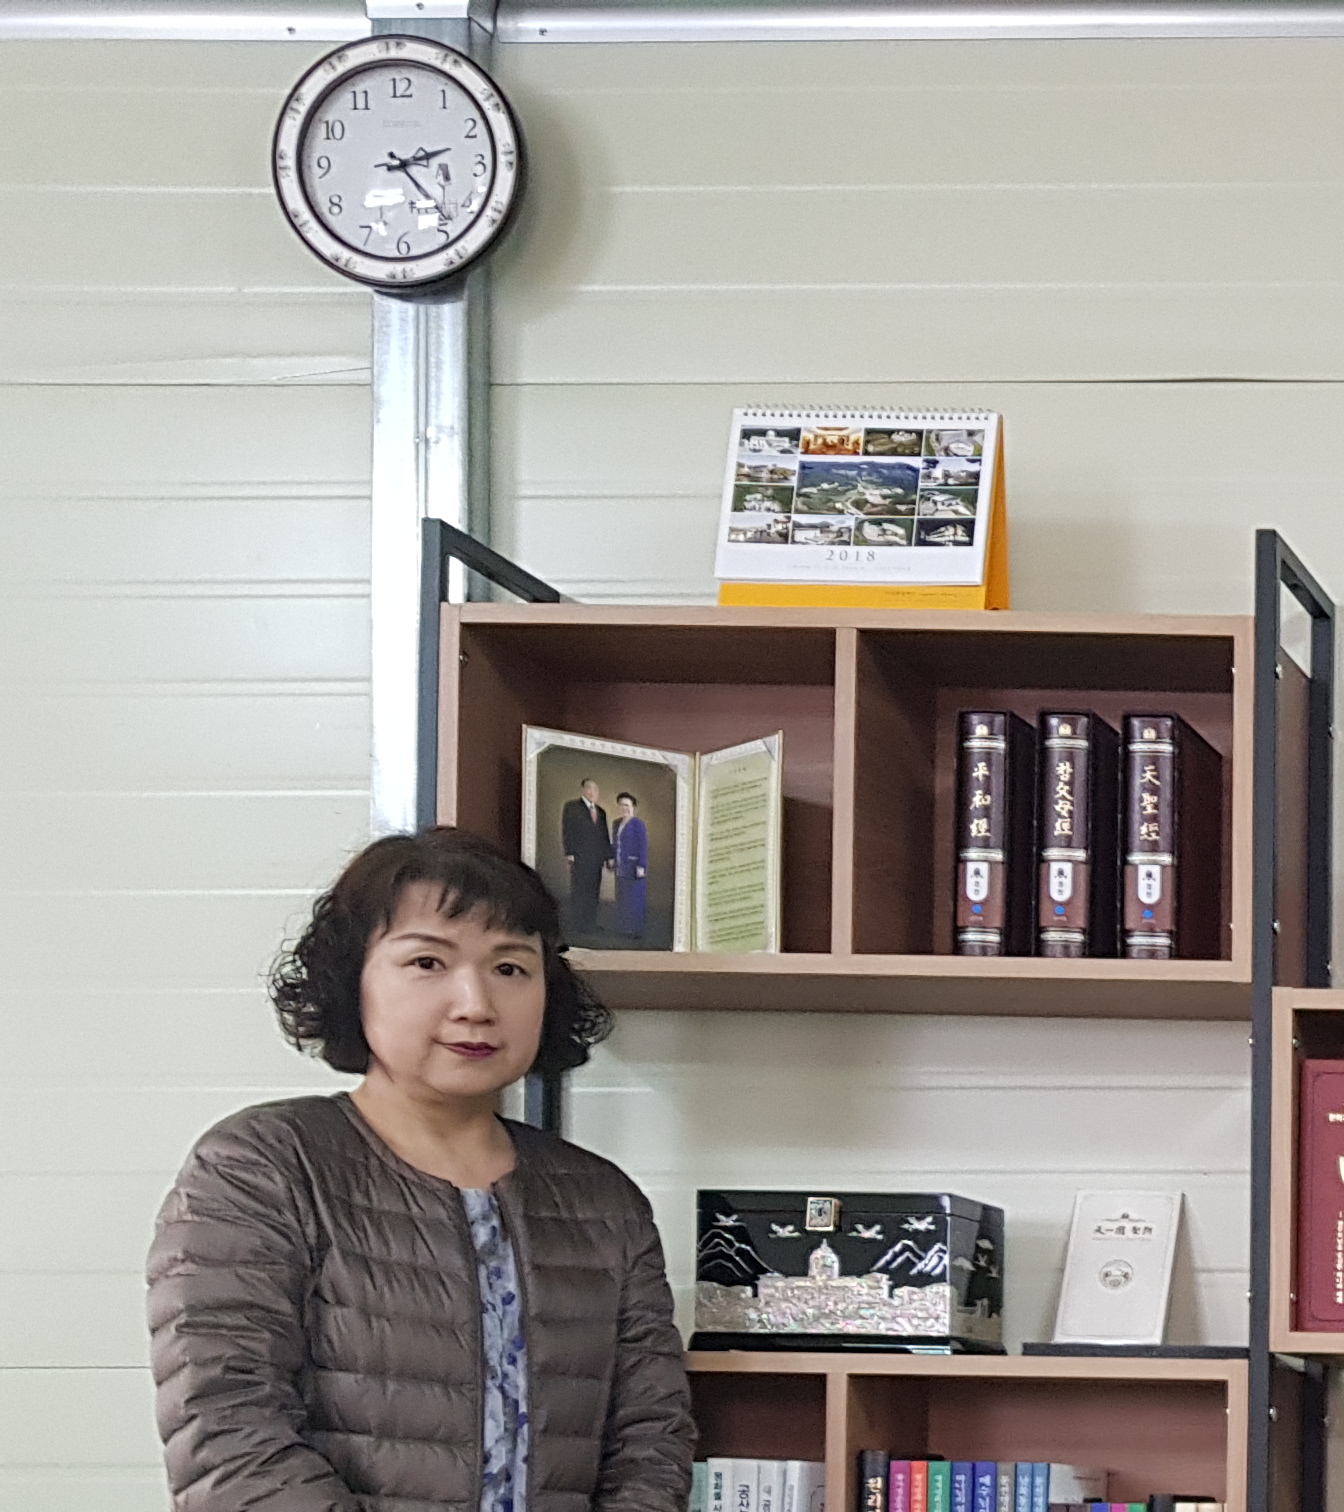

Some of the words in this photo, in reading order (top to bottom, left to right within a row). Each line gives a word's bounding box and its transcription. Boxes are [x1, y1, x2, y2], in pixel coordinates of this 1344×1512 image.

[389, 77, 413, 98] 12
[351, 90, 371, 111] 11
[441, 89, 448, 110] 1
[323, 119, 345, 141] 10
[464, 118, 477, 139] 2
[317, 155, 331, 179] 9
[473, 153, 487, 177] 3
[329, 195, 343, 215] 8
[359, 225, 373, 246] 7
[437, 220, 449, 242] 5
[396, 232, 411, 256] 6
[825, 549, 877, 562] 2018
[969, 762, 992, 838] 平和經
[1139, 765, 1161, 842] 天聖經
